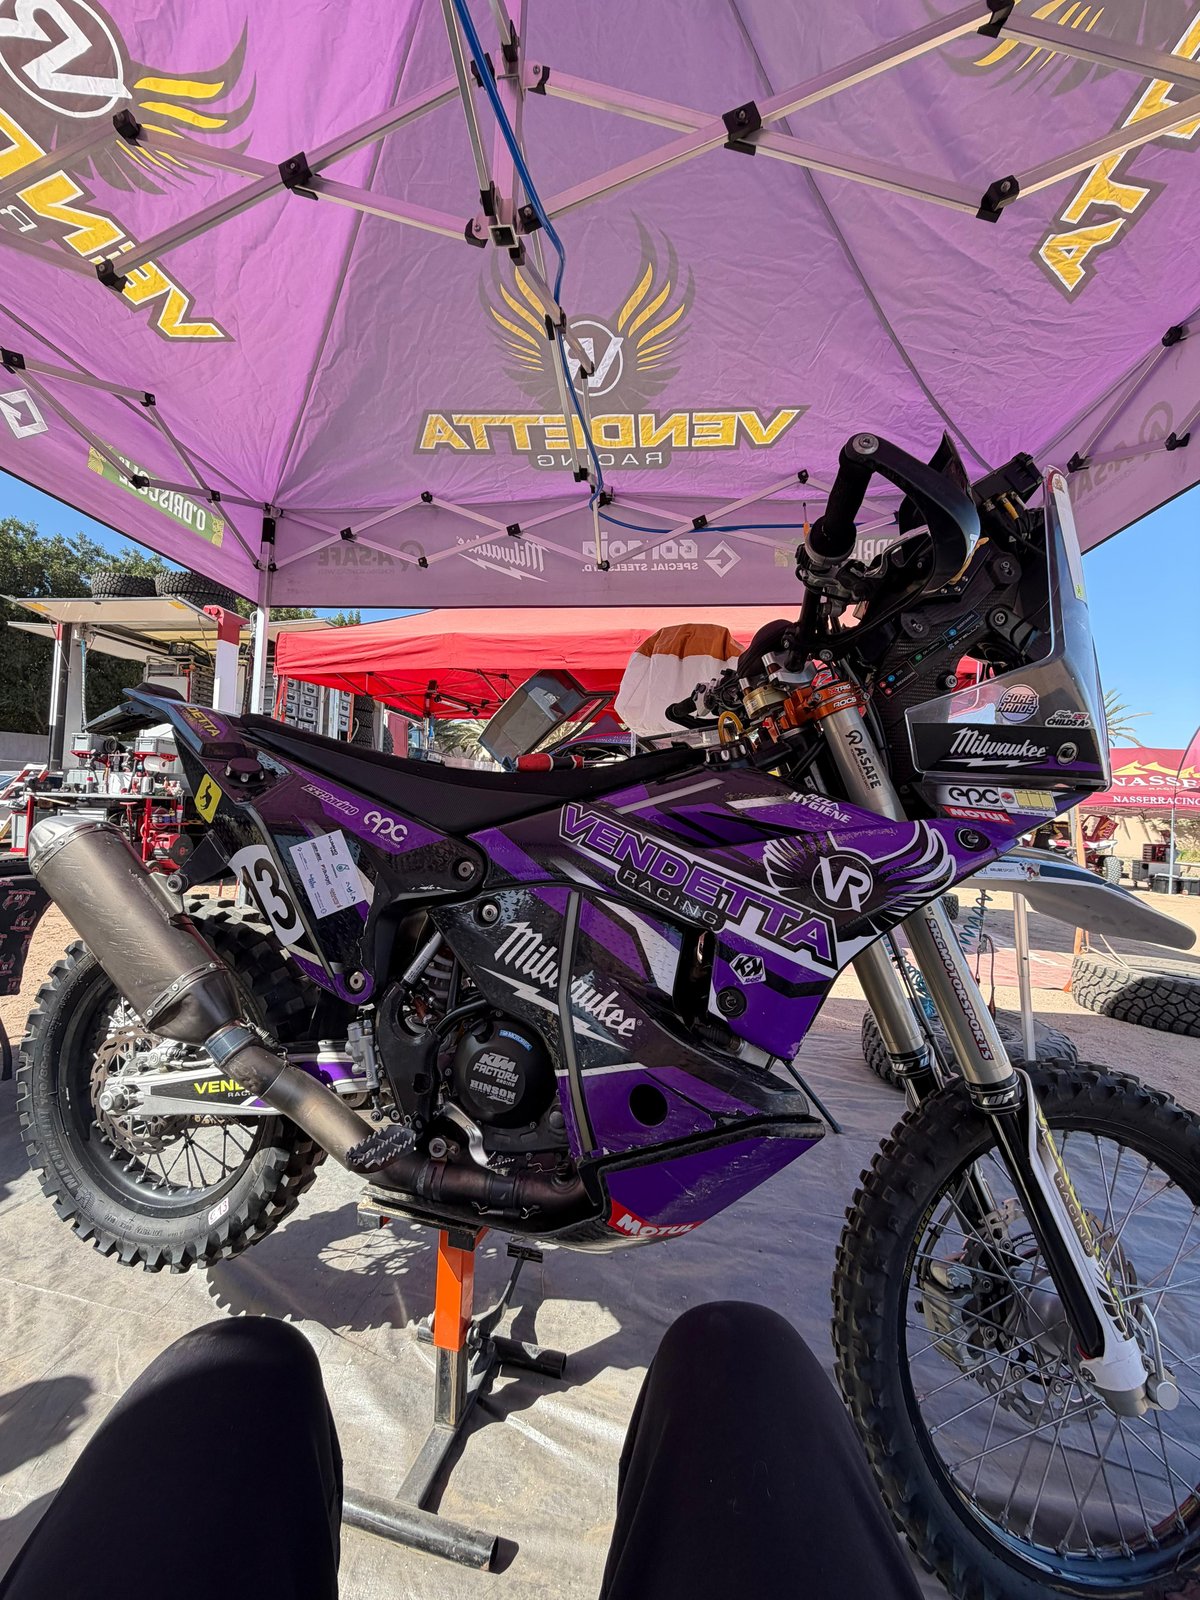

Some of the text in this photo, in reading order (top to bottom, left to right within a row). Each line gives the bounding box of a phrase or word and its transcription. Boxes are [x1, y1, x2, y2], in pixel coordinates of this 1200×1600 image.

[996, 703, 1037, 714] HANDS
[1003, 693, 1037, 704] SORE
[1046, 718, 1078, 726] CHILDS
[949, 727, 1047, 758] Milwaukee
[1112, 775, 1200, 789] NASSE
[788, 791, 852, 824] HYGIENE
[949, 807, 1010, 822] MOTUL
[563, 804, 834, 963] VENDETTA
[622, 870, 719, 926] RACING
[925, 918, 994, 1061] SRGMOTORSPORTS
[472, 1062, 519, 1083] FACTORY
[478, 1052, 517, 1073] KTM
[469, 1079, 517, 1100] HINSON
[616, 1213, 696, 1236] MOTUL
[1056, 1175, 1092, 1253] RACING
